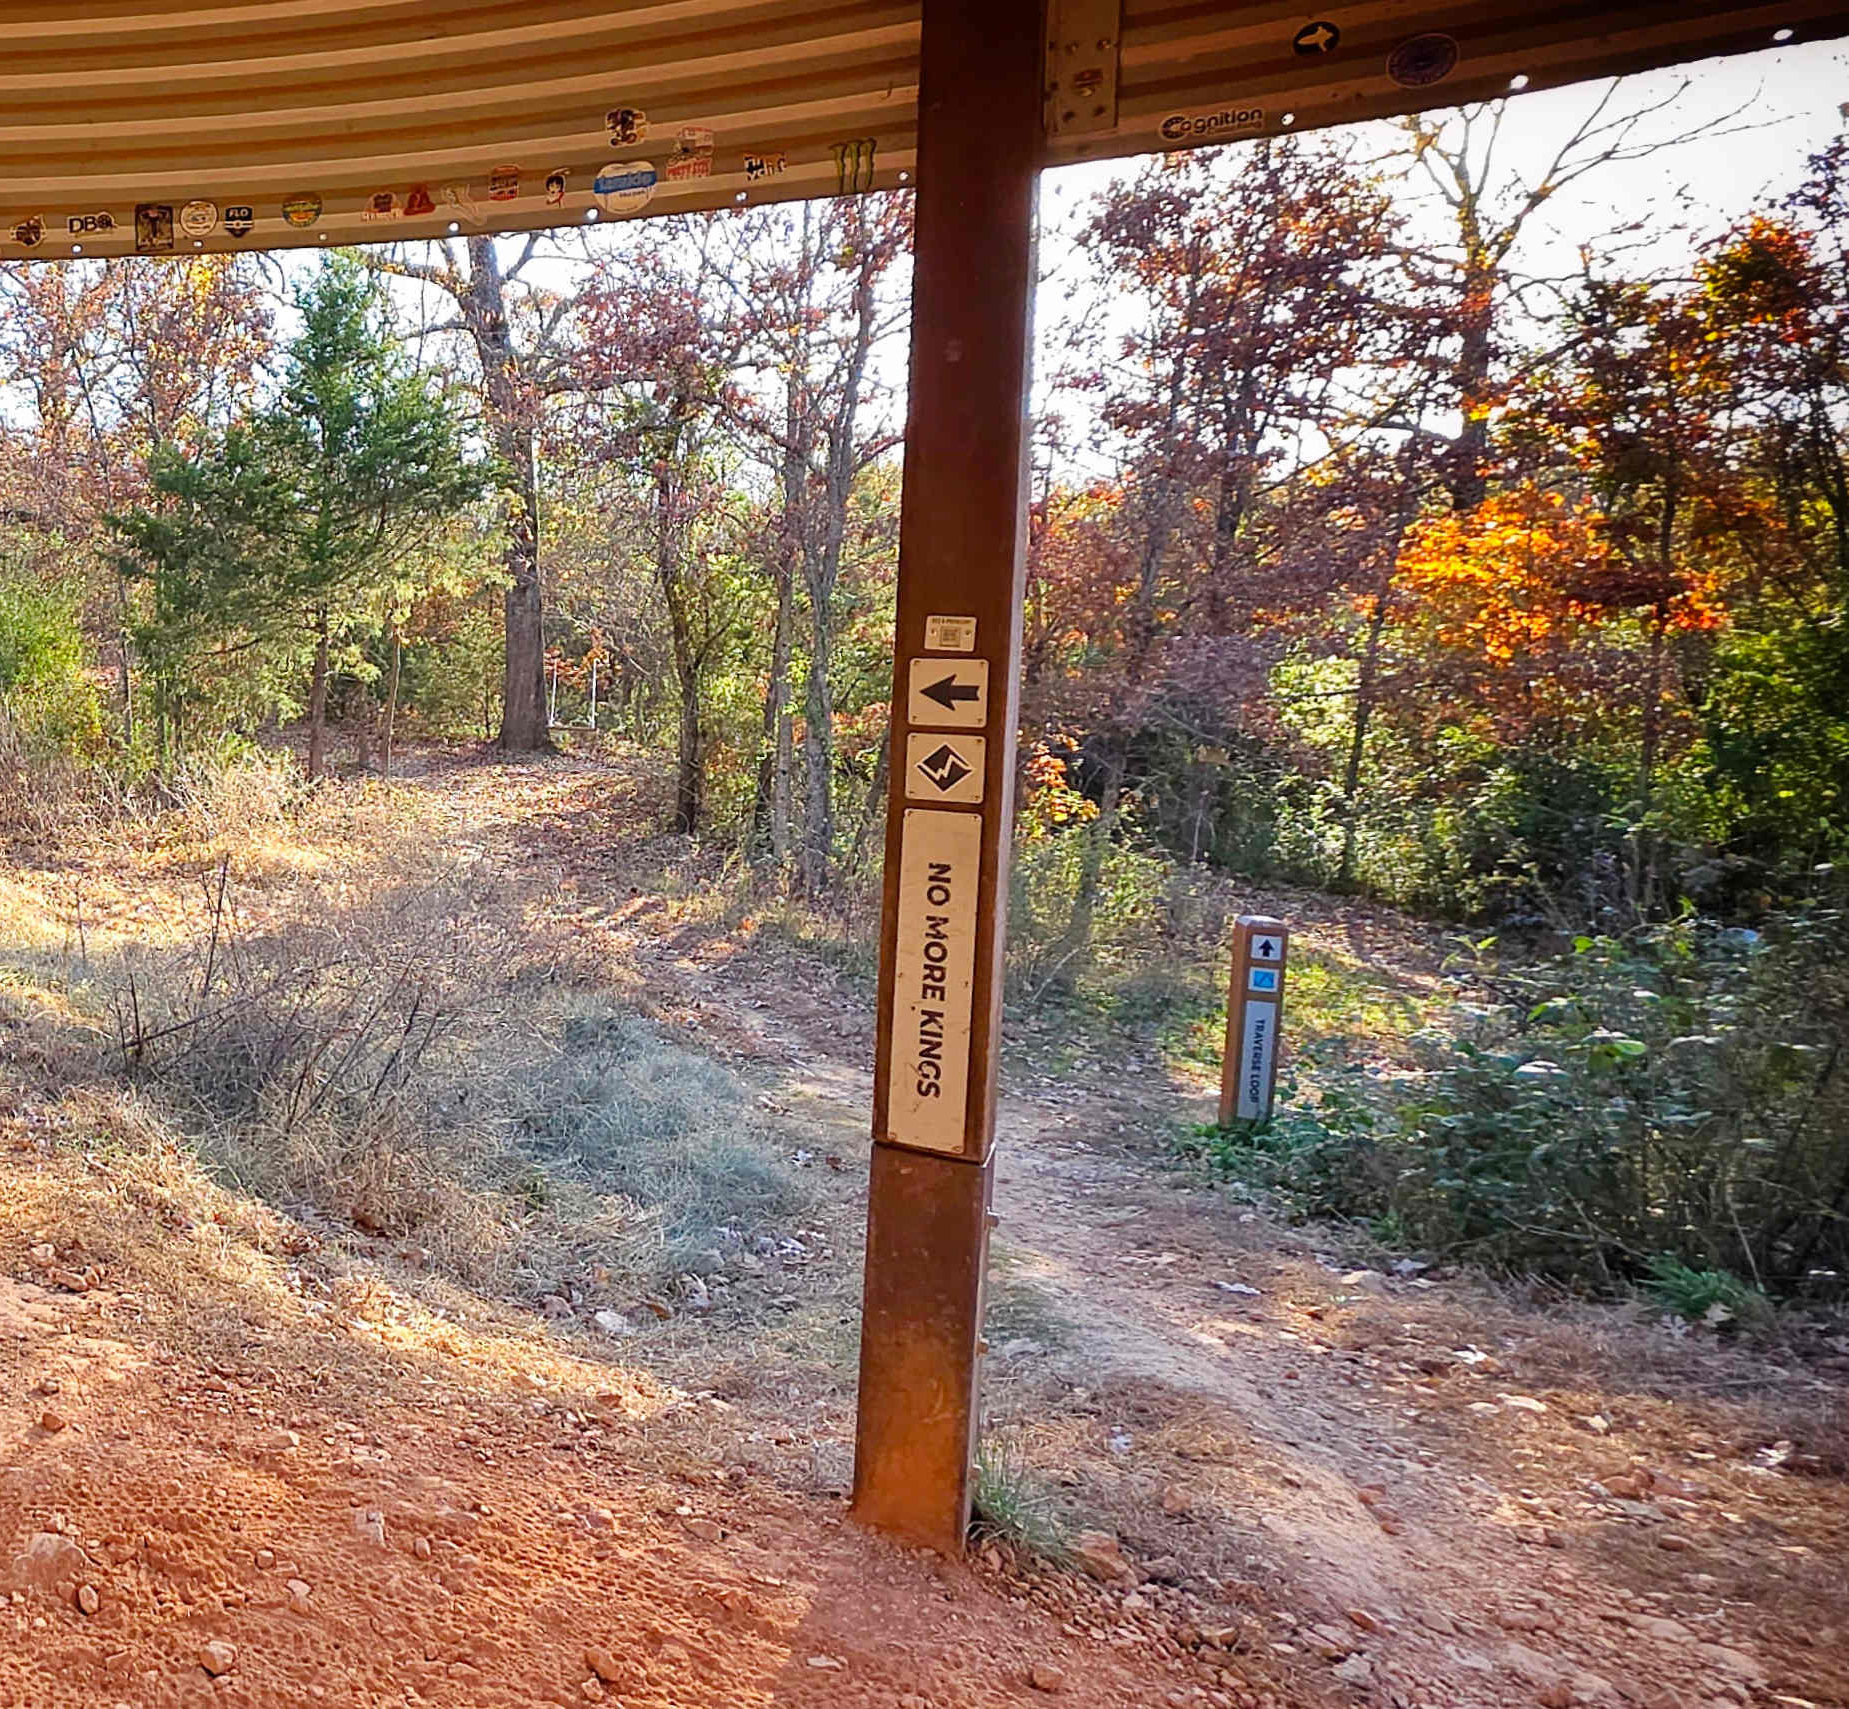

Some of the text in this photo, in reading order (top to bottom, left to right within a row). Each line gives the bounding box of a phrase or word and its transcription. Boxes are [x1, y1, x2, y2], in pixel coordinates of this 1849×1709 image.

[1161, 109, 1263, 139] Cognition
[228, 207, 249, 218] FLO
[917, 862, 952, 1098] NO MORE KINGS
[1249, 1019, 1265, 1104] TRAVERSE LOOP
